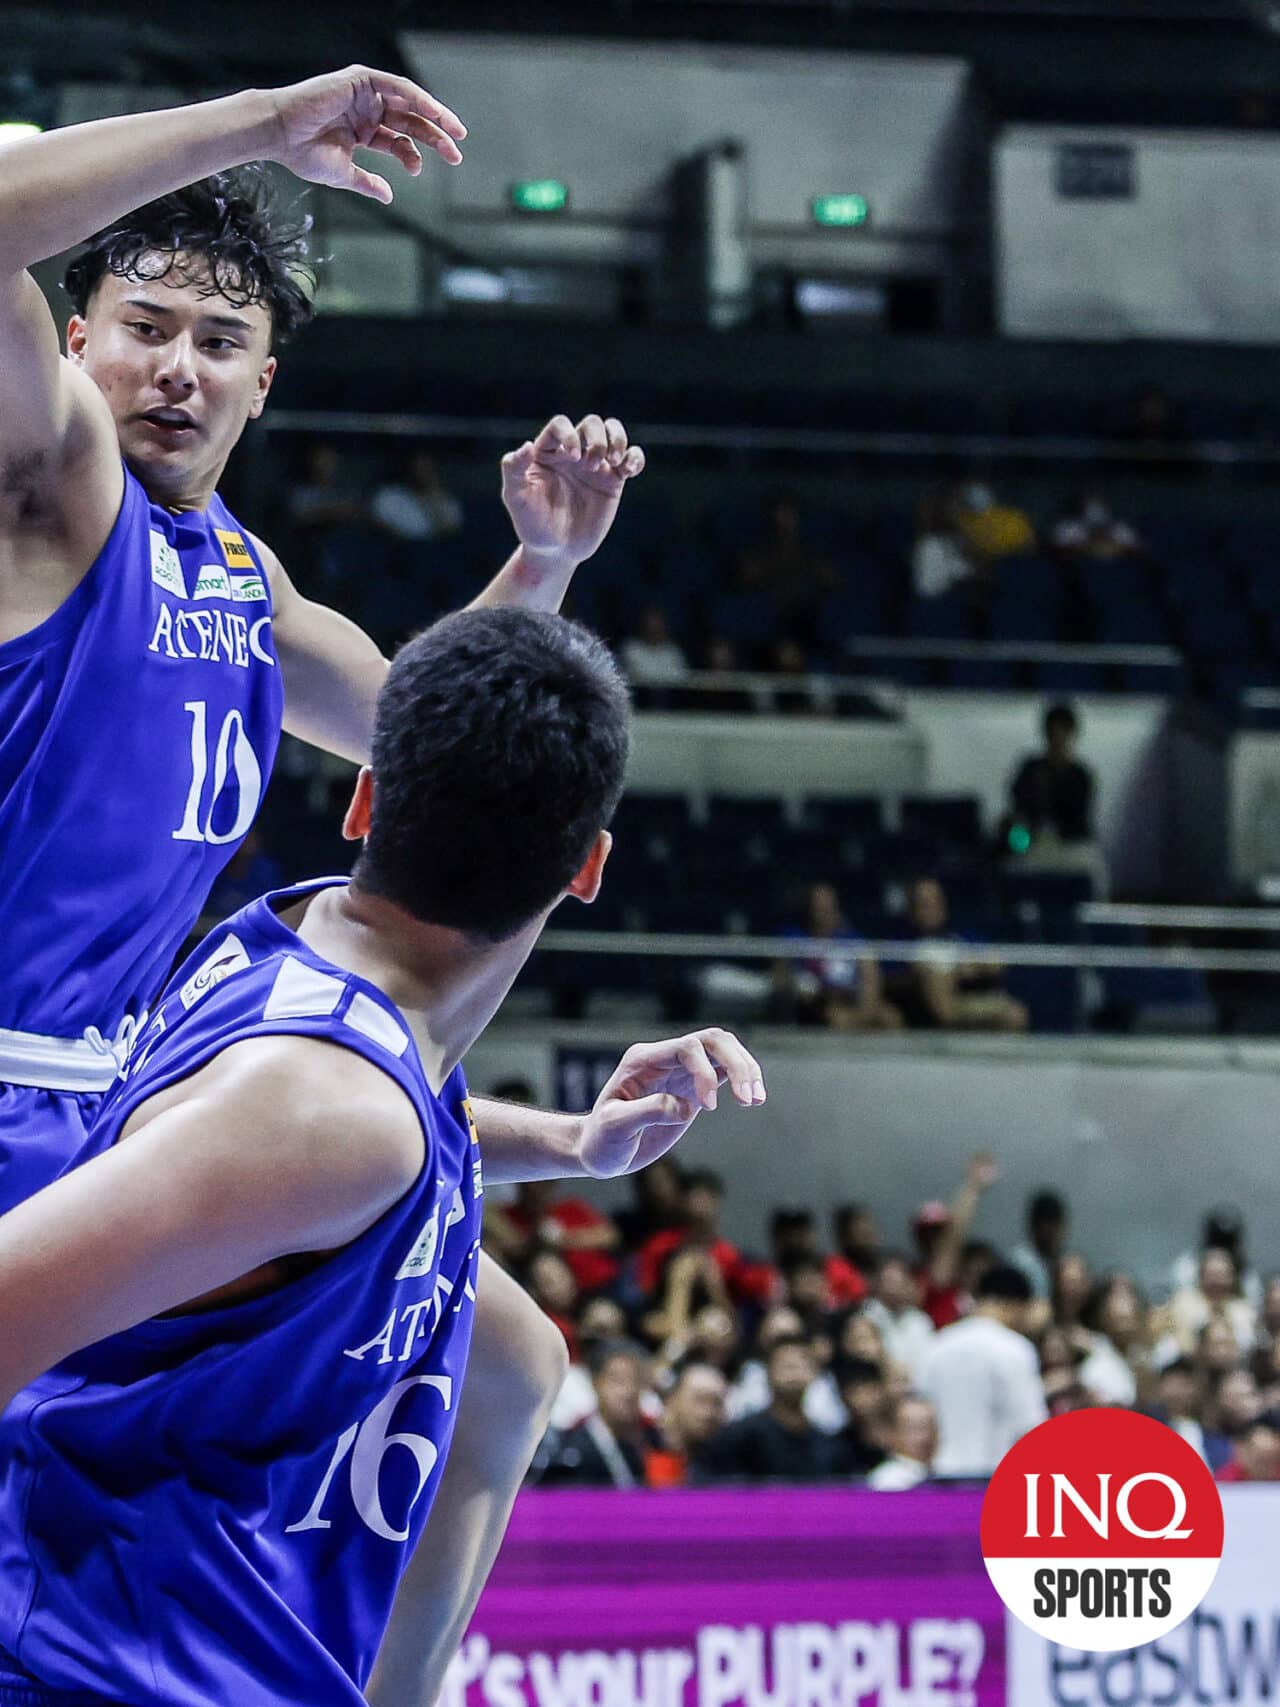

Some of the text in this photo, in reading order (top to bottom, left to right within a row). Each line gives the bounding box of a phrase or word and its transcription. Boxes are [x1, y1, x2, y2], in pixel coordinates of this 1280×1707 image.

[172, 701, 261, 844] 10
[285, 1375, 451, 1541] 16
[528, 1648, 694, 1707] your
